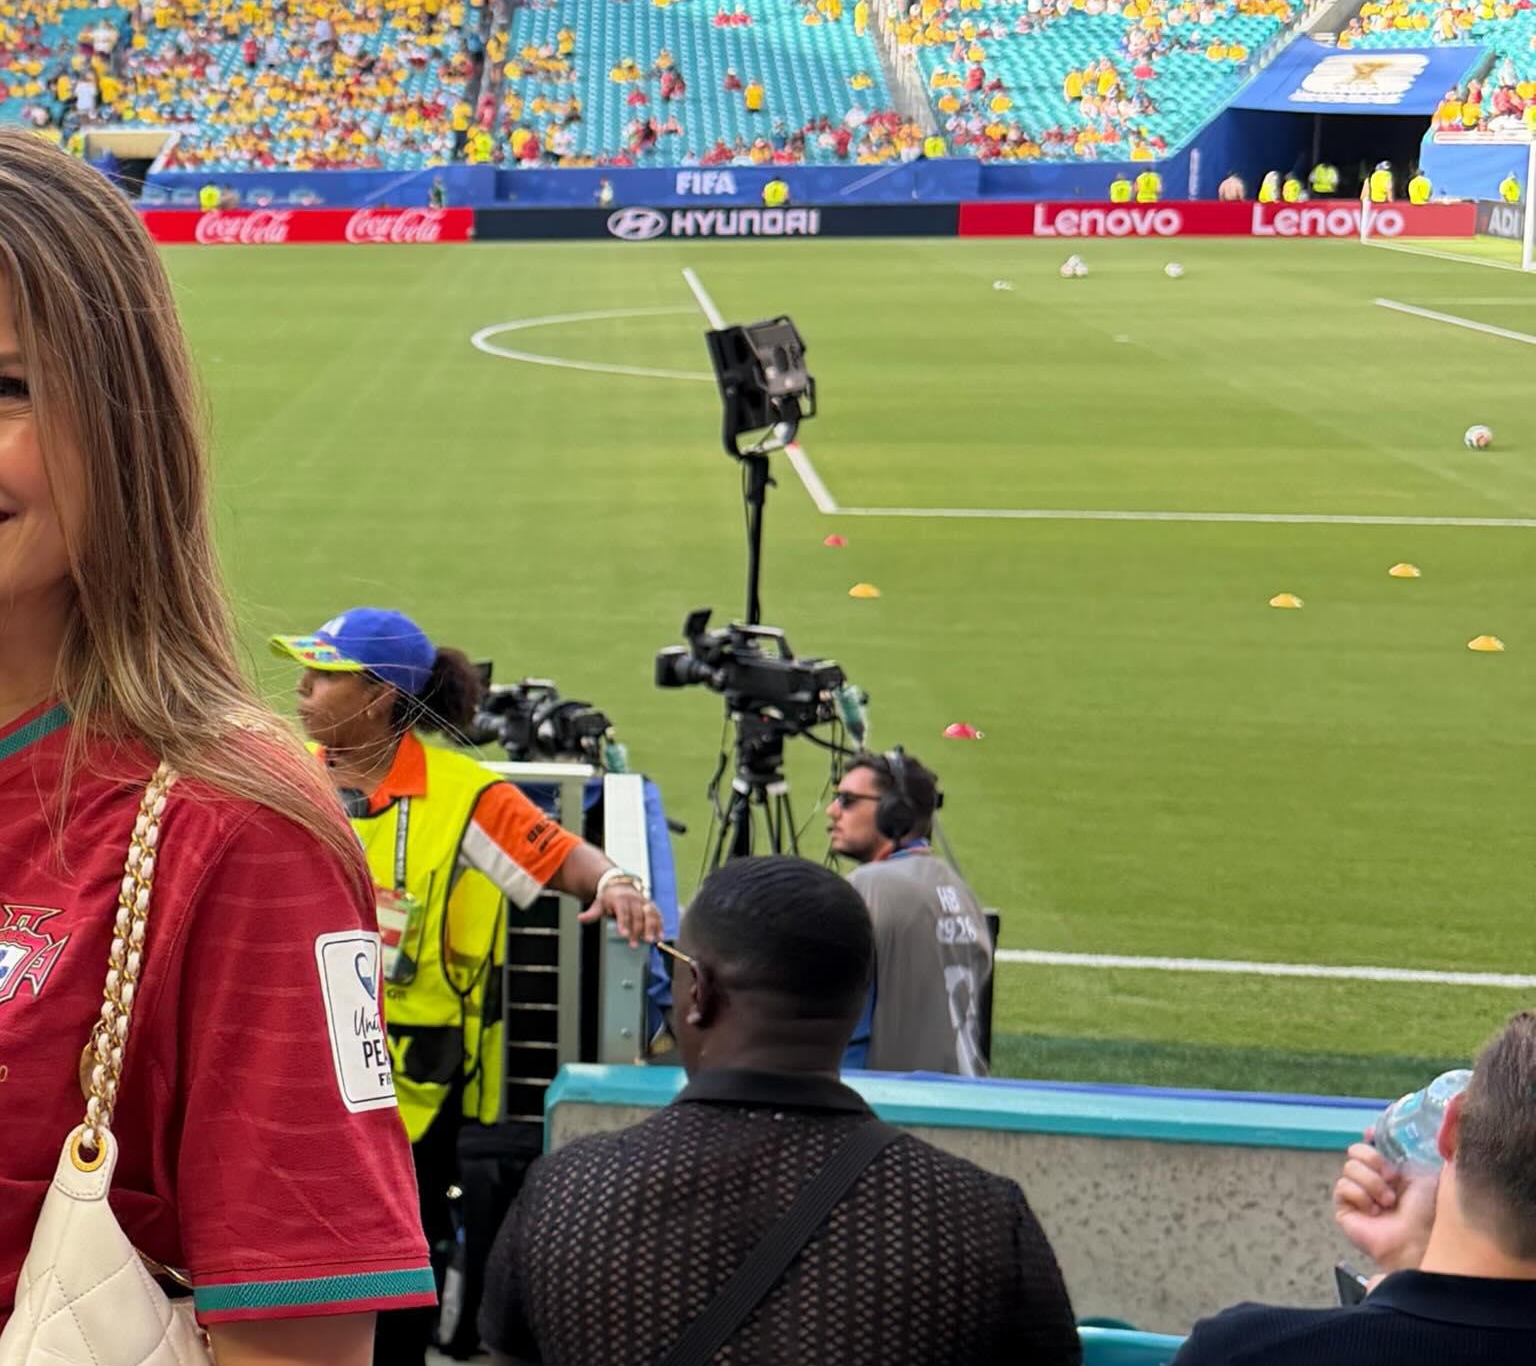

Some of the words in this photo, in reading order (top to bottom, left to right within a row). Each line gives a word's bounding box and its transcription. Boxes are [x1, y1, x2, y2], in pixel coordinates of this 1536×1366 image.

[675, 171, 737, 195] FIFA
[670, 210, 821, 236] HYUNDAI
[1033, 204, 1182, 236] Lenovo
[1251, 205, 1407, 236] Lenovo
[362, 1039, 387, 1069] PE
